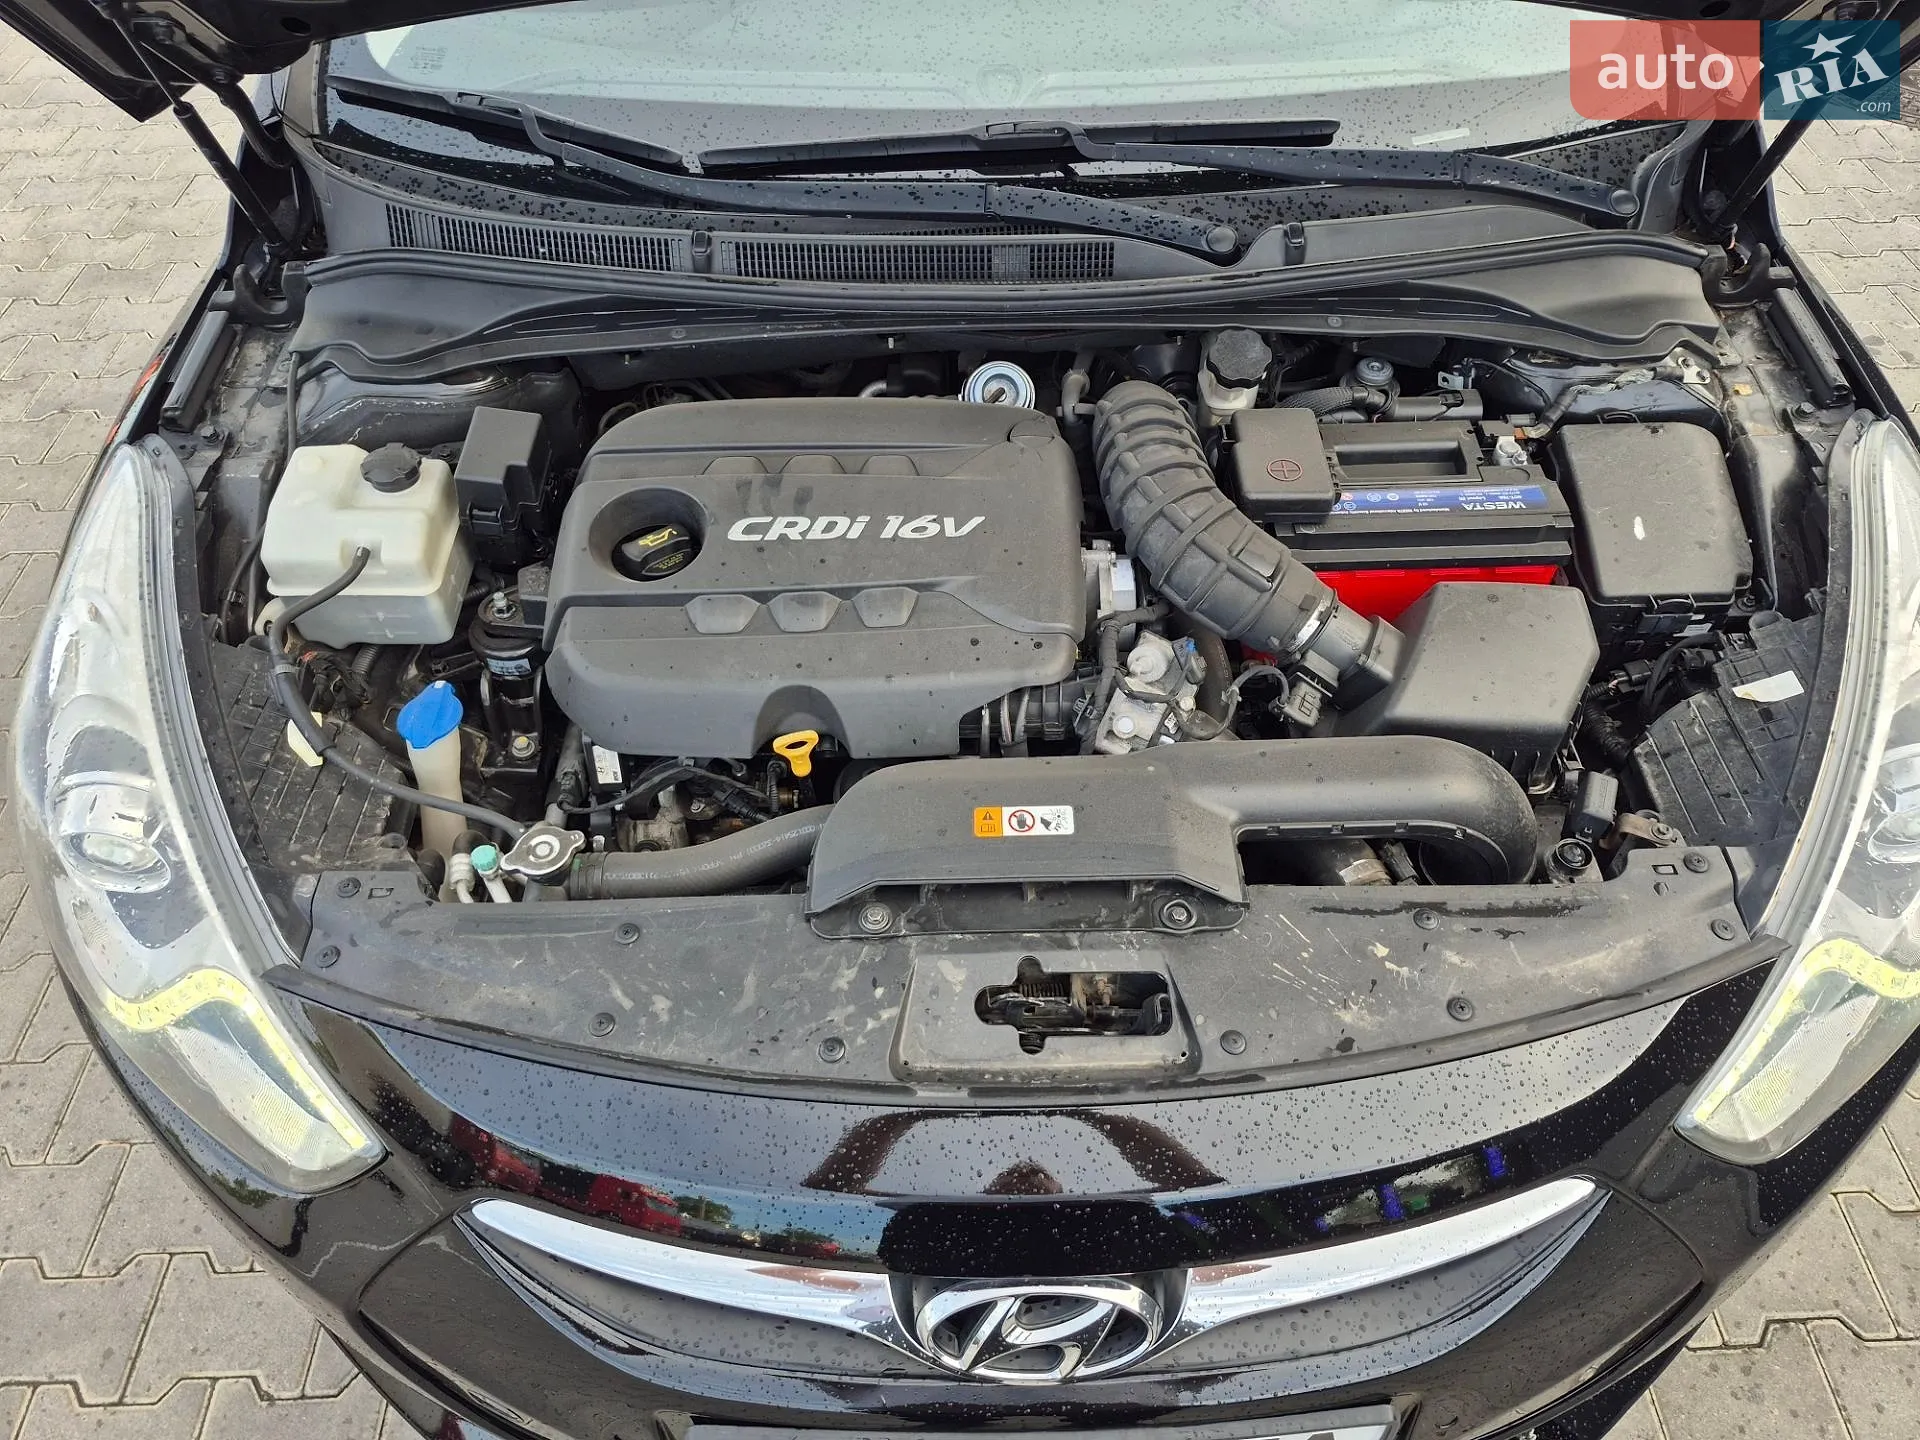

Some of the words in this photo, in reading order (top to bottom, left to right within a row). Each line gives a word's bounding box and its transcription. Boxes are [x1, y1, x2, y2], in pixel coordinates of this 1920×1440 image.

[1461, 501, 1527, 512] WESTA
[727, 515, 871, 541] CRDi
[879, 514, 986, 539] 16V
